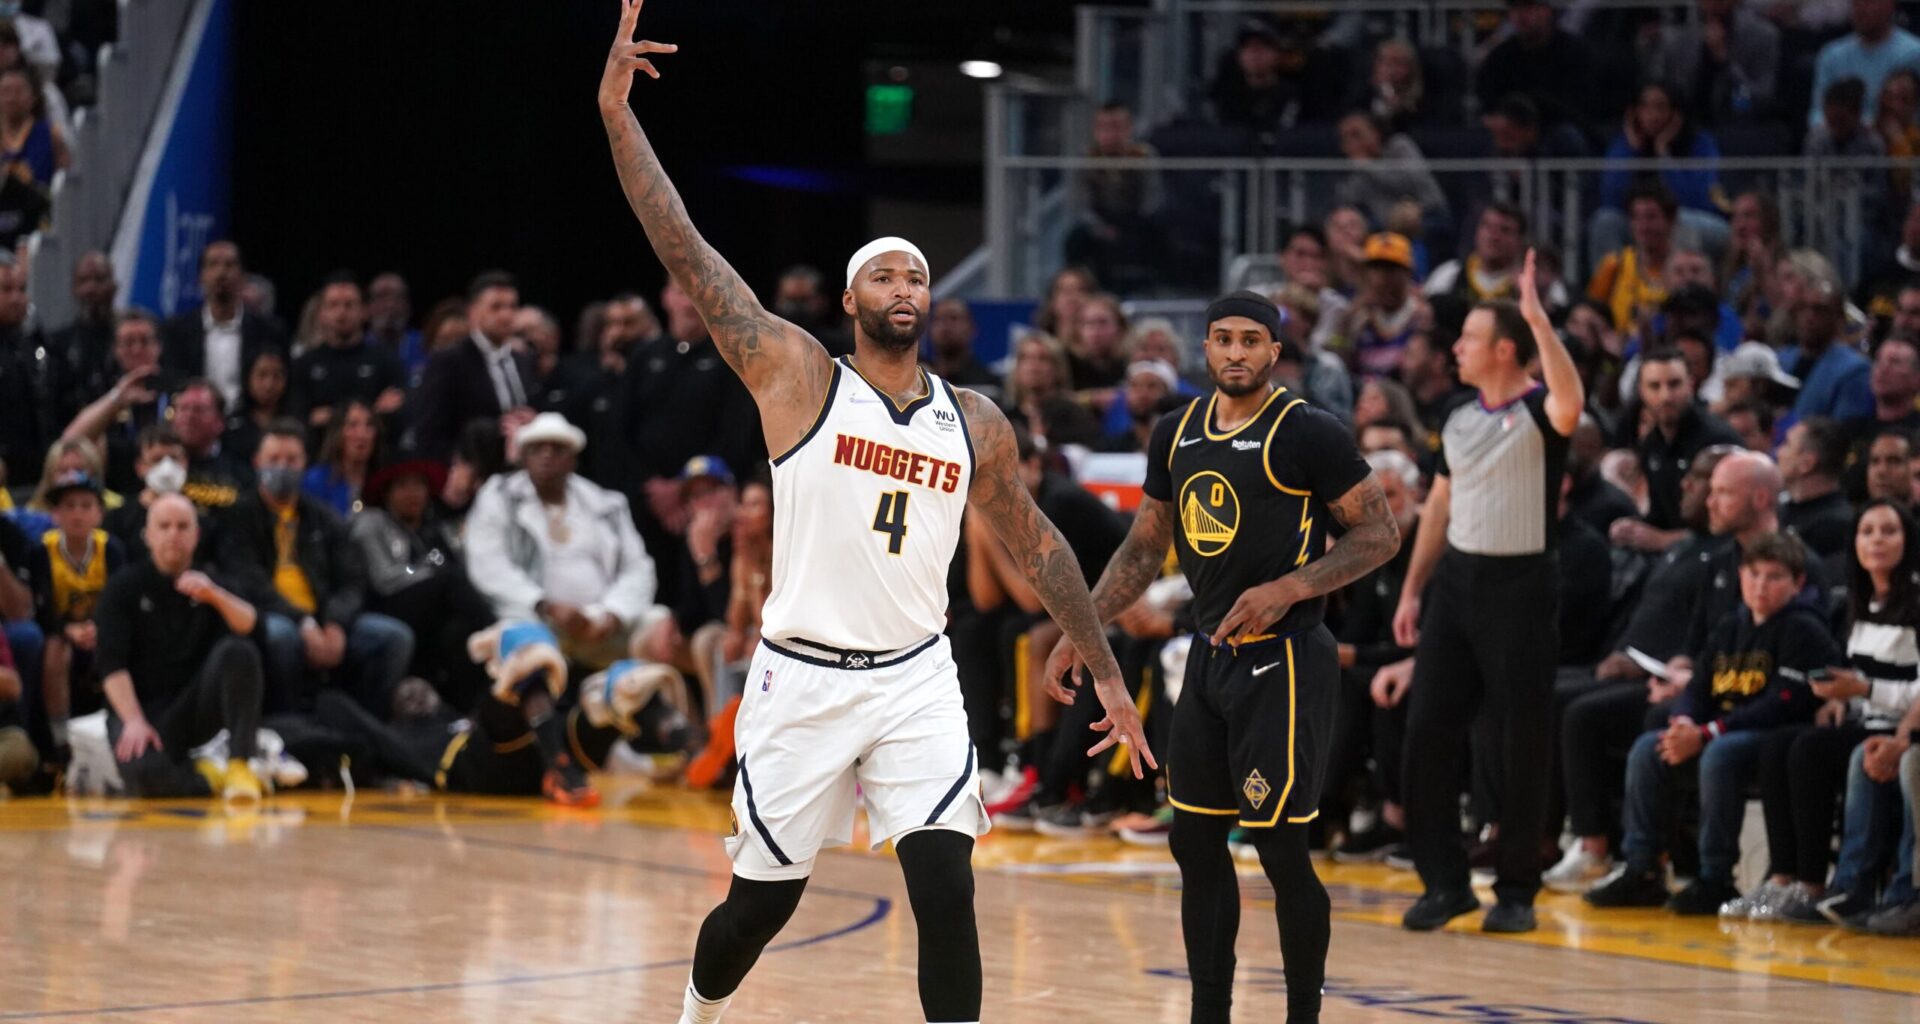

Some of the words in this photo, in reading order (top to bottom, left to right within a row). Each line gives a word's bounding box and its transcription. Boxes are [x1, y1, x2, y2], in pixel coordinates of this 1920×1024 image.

[932, 408, 955, 422] WU
[1231, 439, 1261, 450] Rakuten
[833, 433, 961, 494] NUGGETS
[1211, 483, 1224, 507] 0
[872, 490, 910, 557] 4
